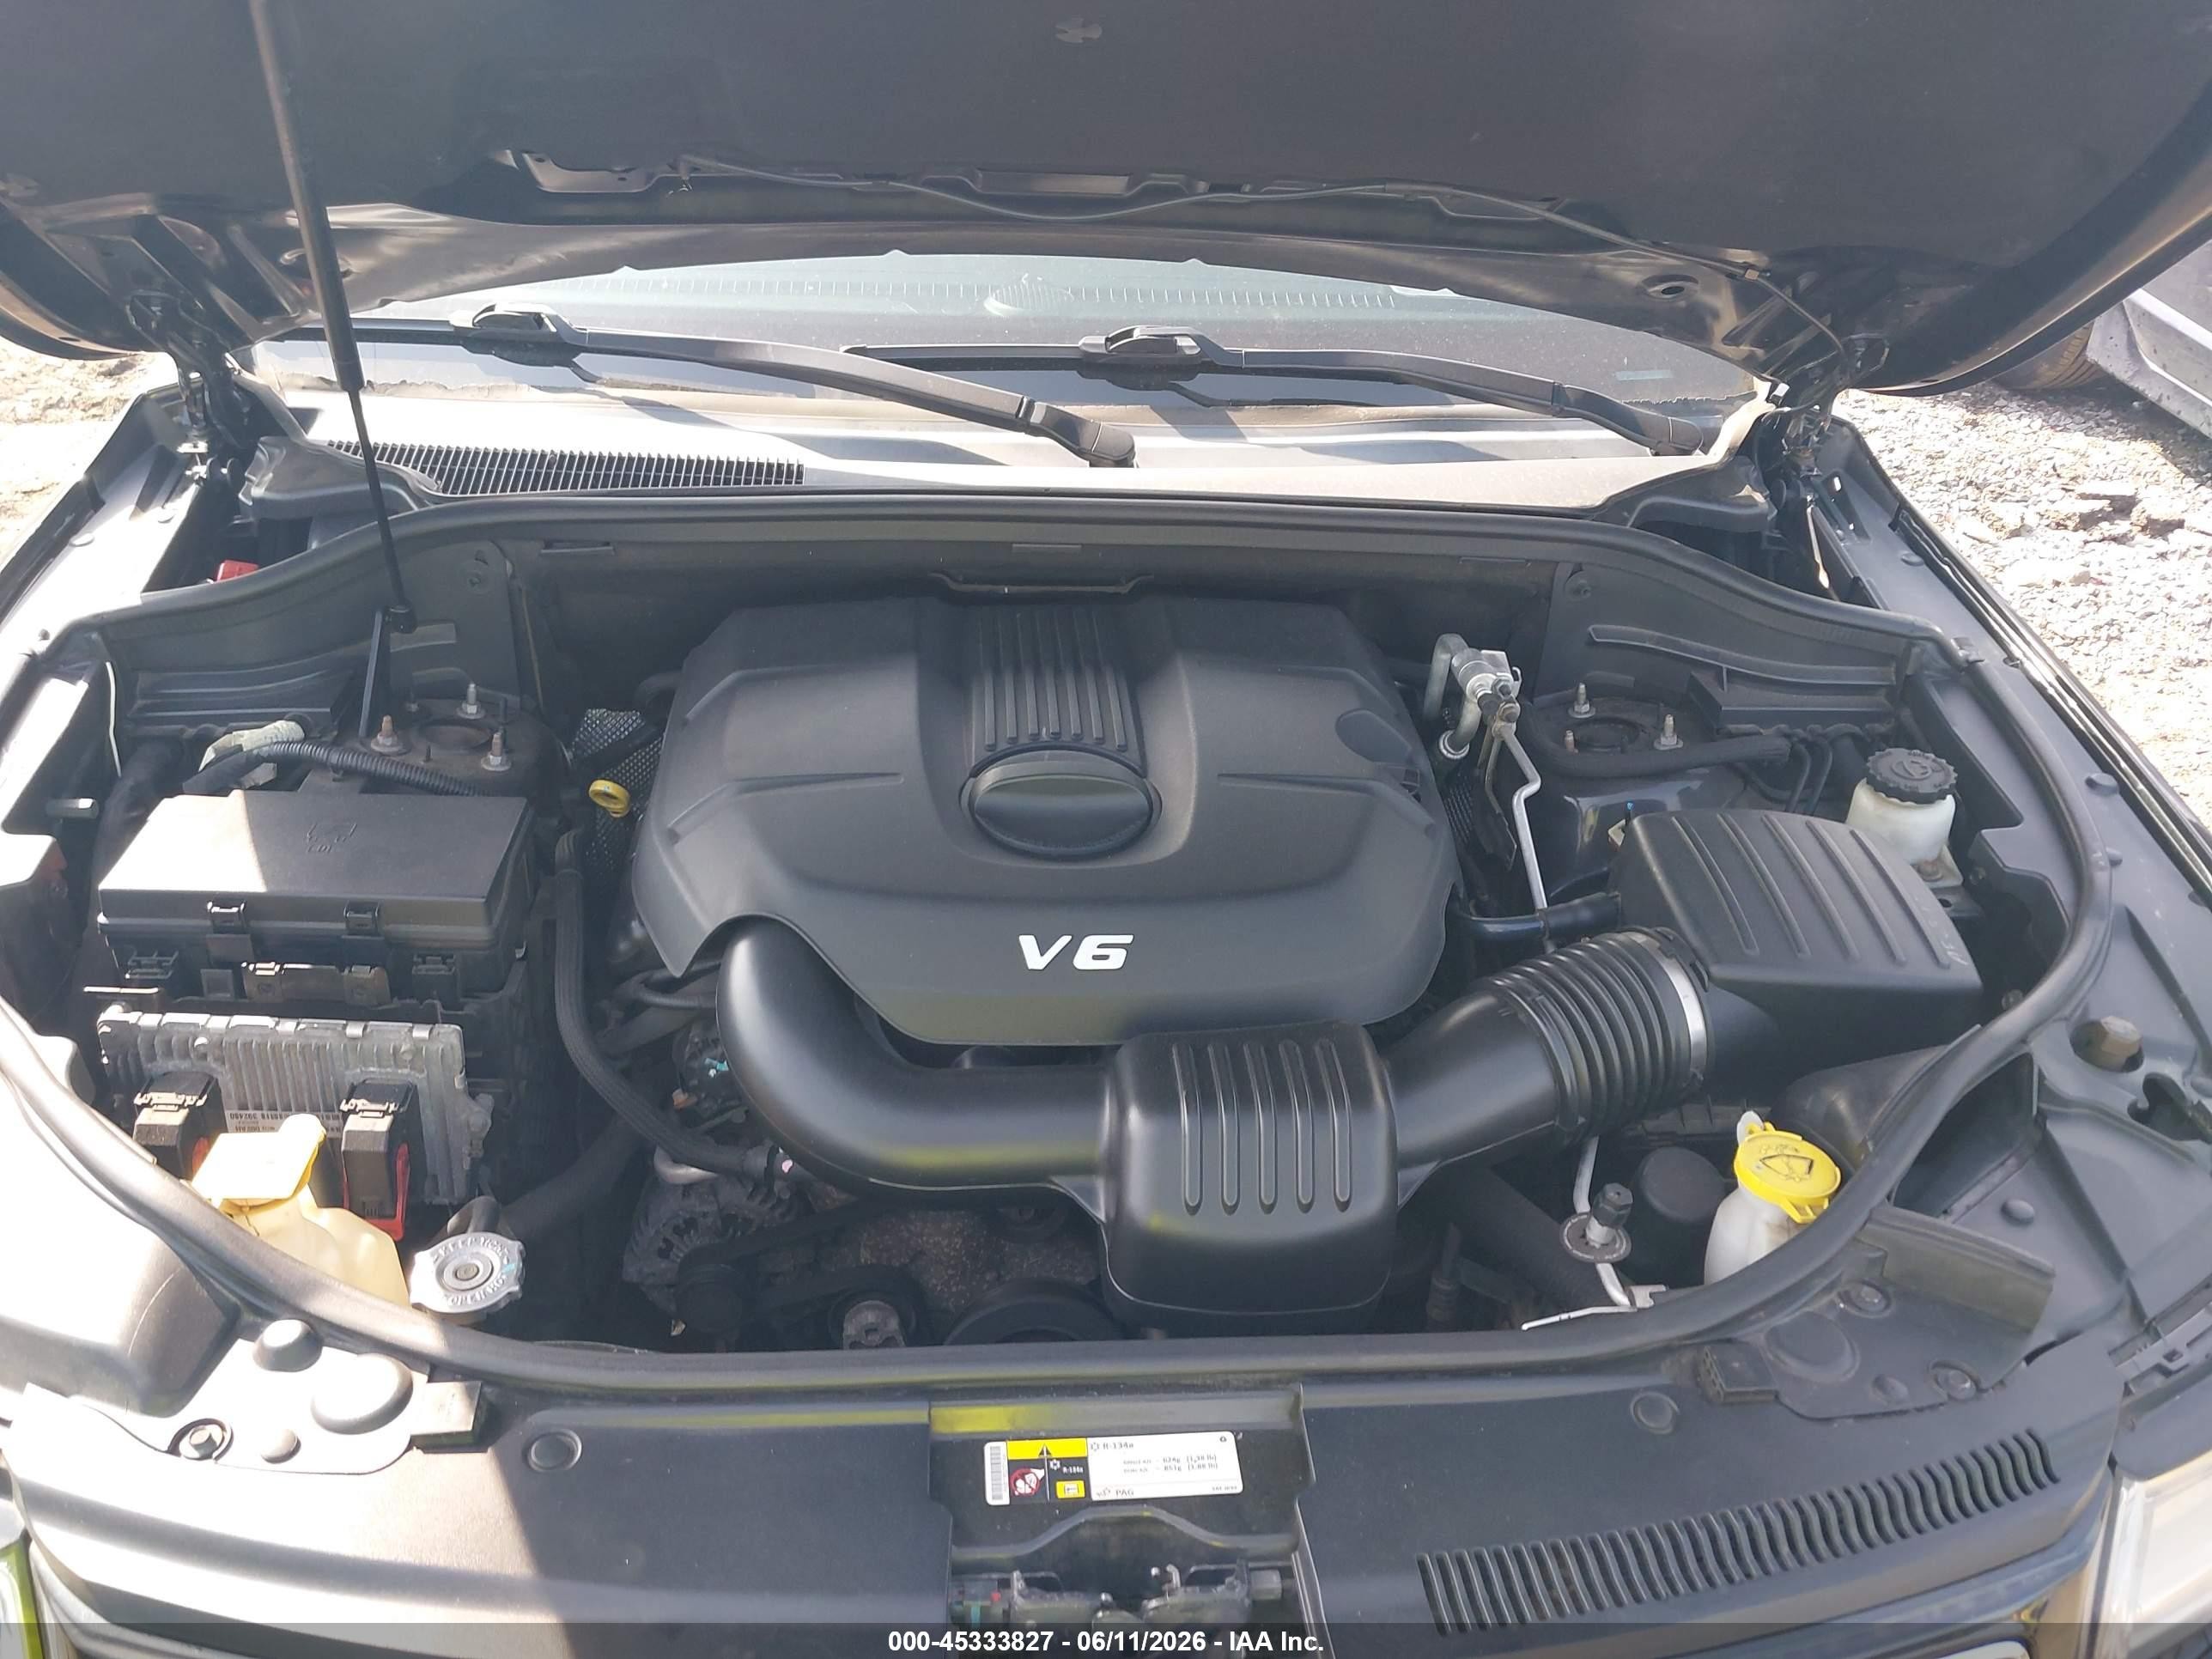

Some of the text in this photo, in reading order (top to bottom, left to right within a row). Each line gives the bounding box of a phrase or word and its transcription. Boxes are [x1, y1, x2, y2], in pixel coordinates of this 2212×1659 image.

[1018, 934, 1134, 970] V6
[1103, 1442, 1134, 1450] R-134a
[1115, 1488, 1134, 1497] PAG
